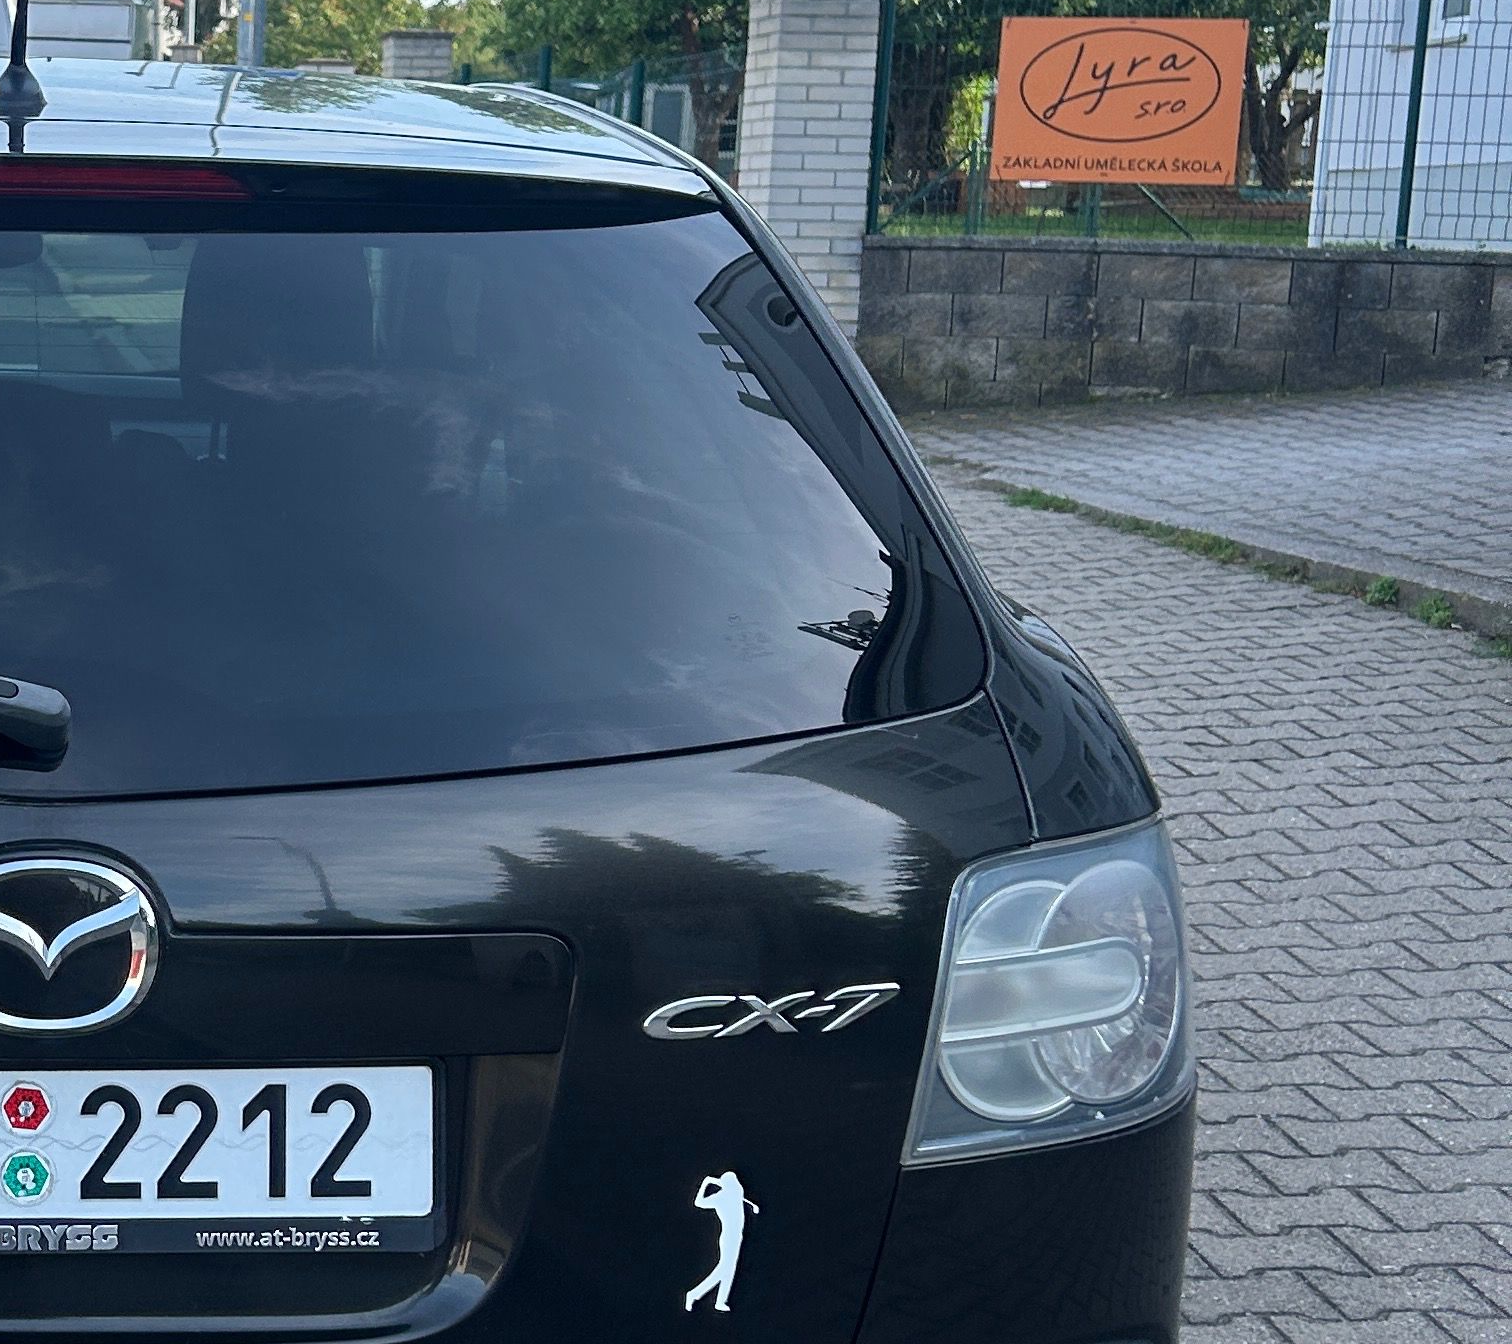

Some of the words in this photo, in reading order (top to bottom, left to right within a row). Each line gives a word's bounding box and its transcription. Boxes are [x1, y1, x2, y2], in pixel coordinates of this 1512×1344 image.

[1042, 42, 1196, 120] Lyra
[1002, 155, 1081, 171] ZÁKLADNÍ
[1084, 156, 1168, 173] UMĚLECKÁ
[1171, 157, 1223, 173] ŠKOLA
[642, 982, 901, 1040] CX-7
[79, 1083, 373, 1200] 2212
[195, 1226, 381, 1252] www.at-bryss.cz
